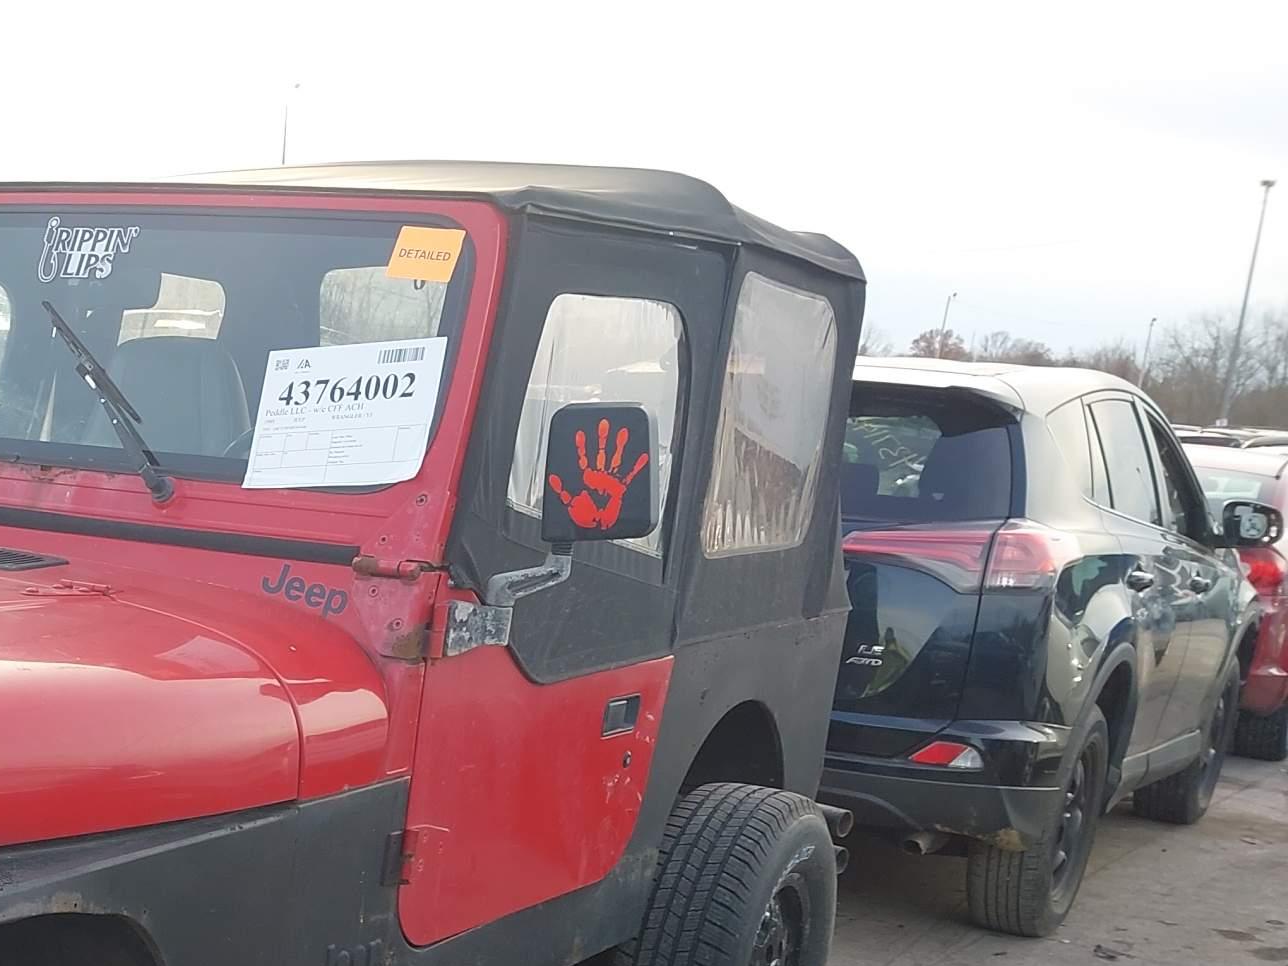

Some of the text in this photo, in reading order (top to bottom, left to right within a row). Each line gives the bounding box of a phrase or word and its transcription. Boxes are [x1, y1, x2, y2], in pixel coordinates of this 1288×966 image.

[60, 252, 115, 279] LIPS
[398, 247, 452, 262] DETAILED
[278, 372, 417, 407] 43764002
[290, 406, 307, 416] LLC
[262, 563, 349, 618] Jeep
